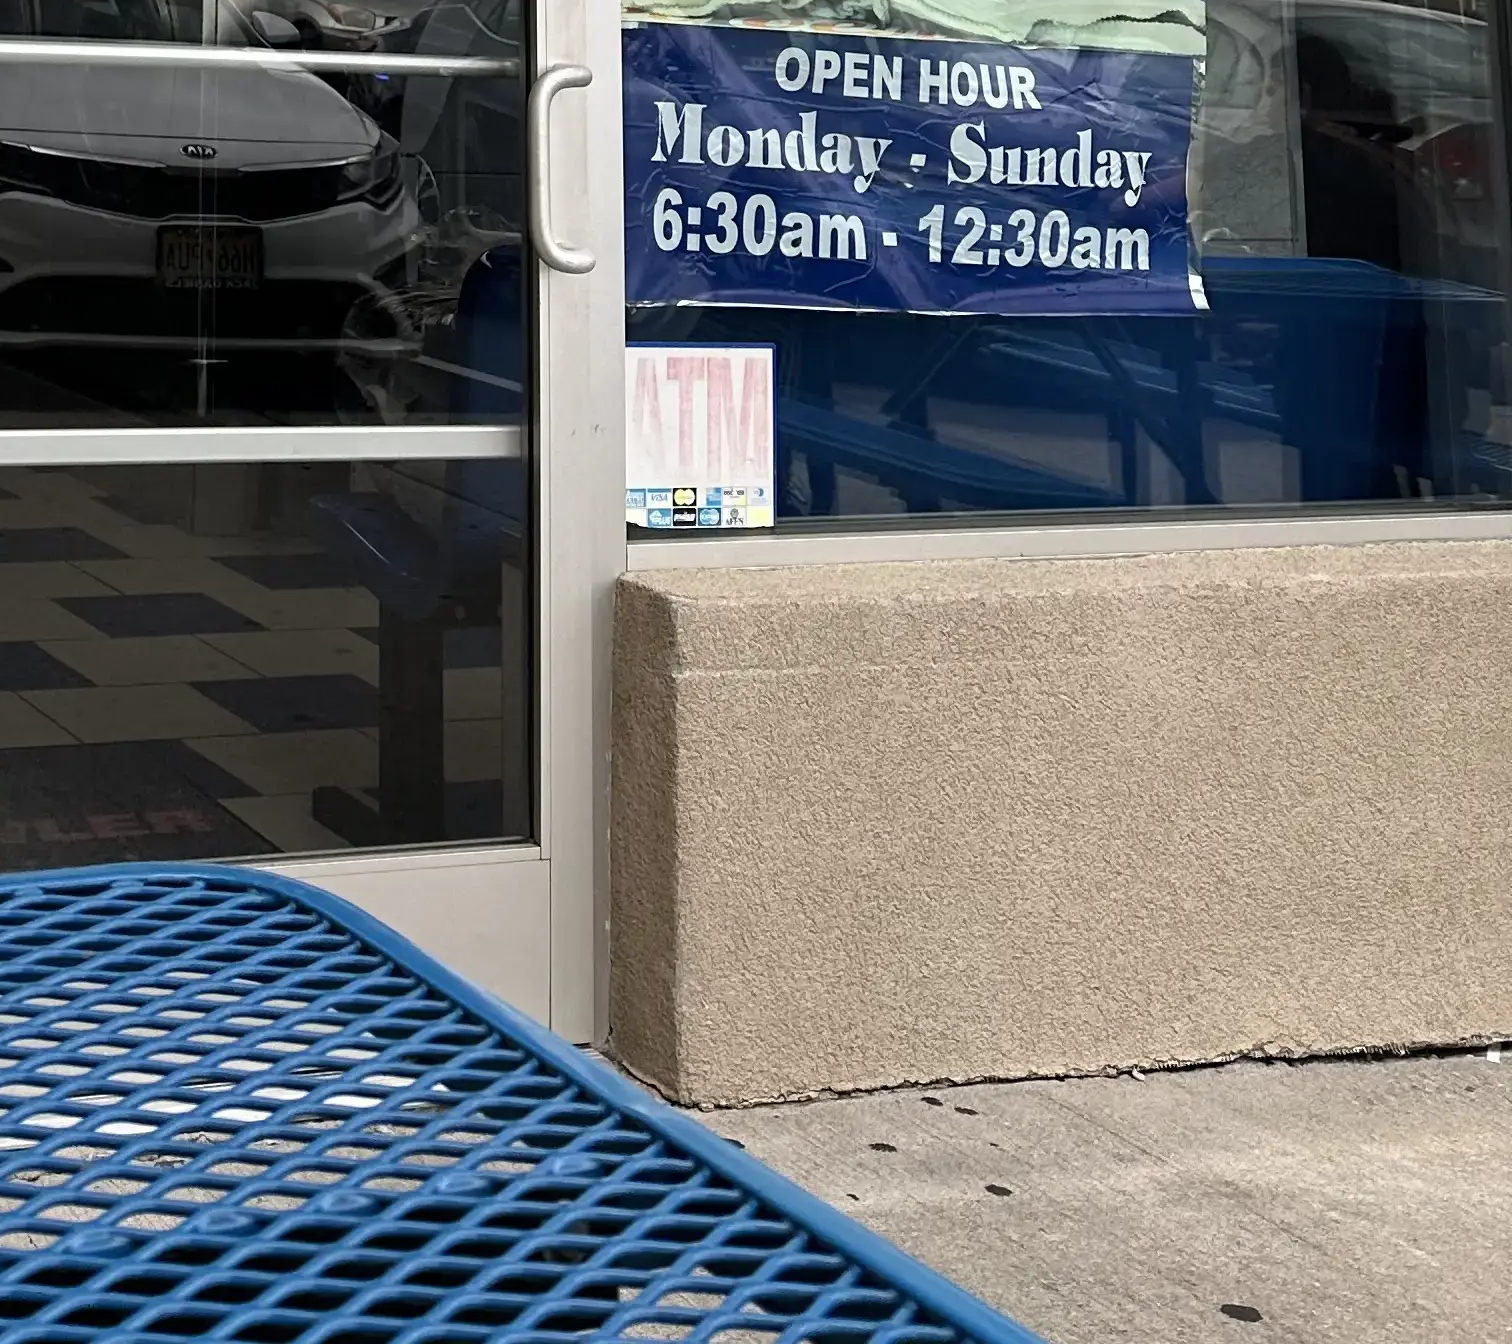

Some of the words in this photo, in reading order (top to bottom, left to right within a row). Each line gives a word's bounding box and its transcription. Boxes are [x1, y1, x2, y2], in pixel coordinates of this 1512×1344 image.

[774, 47, 903, 101] OPEN
[919, 58, 1042, 111] HOUR
[650, 101, 893, 194] Monday
[947, 120, 1152, 208] Sunday
[652, 188, 868, 261] 6:30am
[918, 203, 1150, 272] 12:30am
[632, 357, 768, 482] ATM
